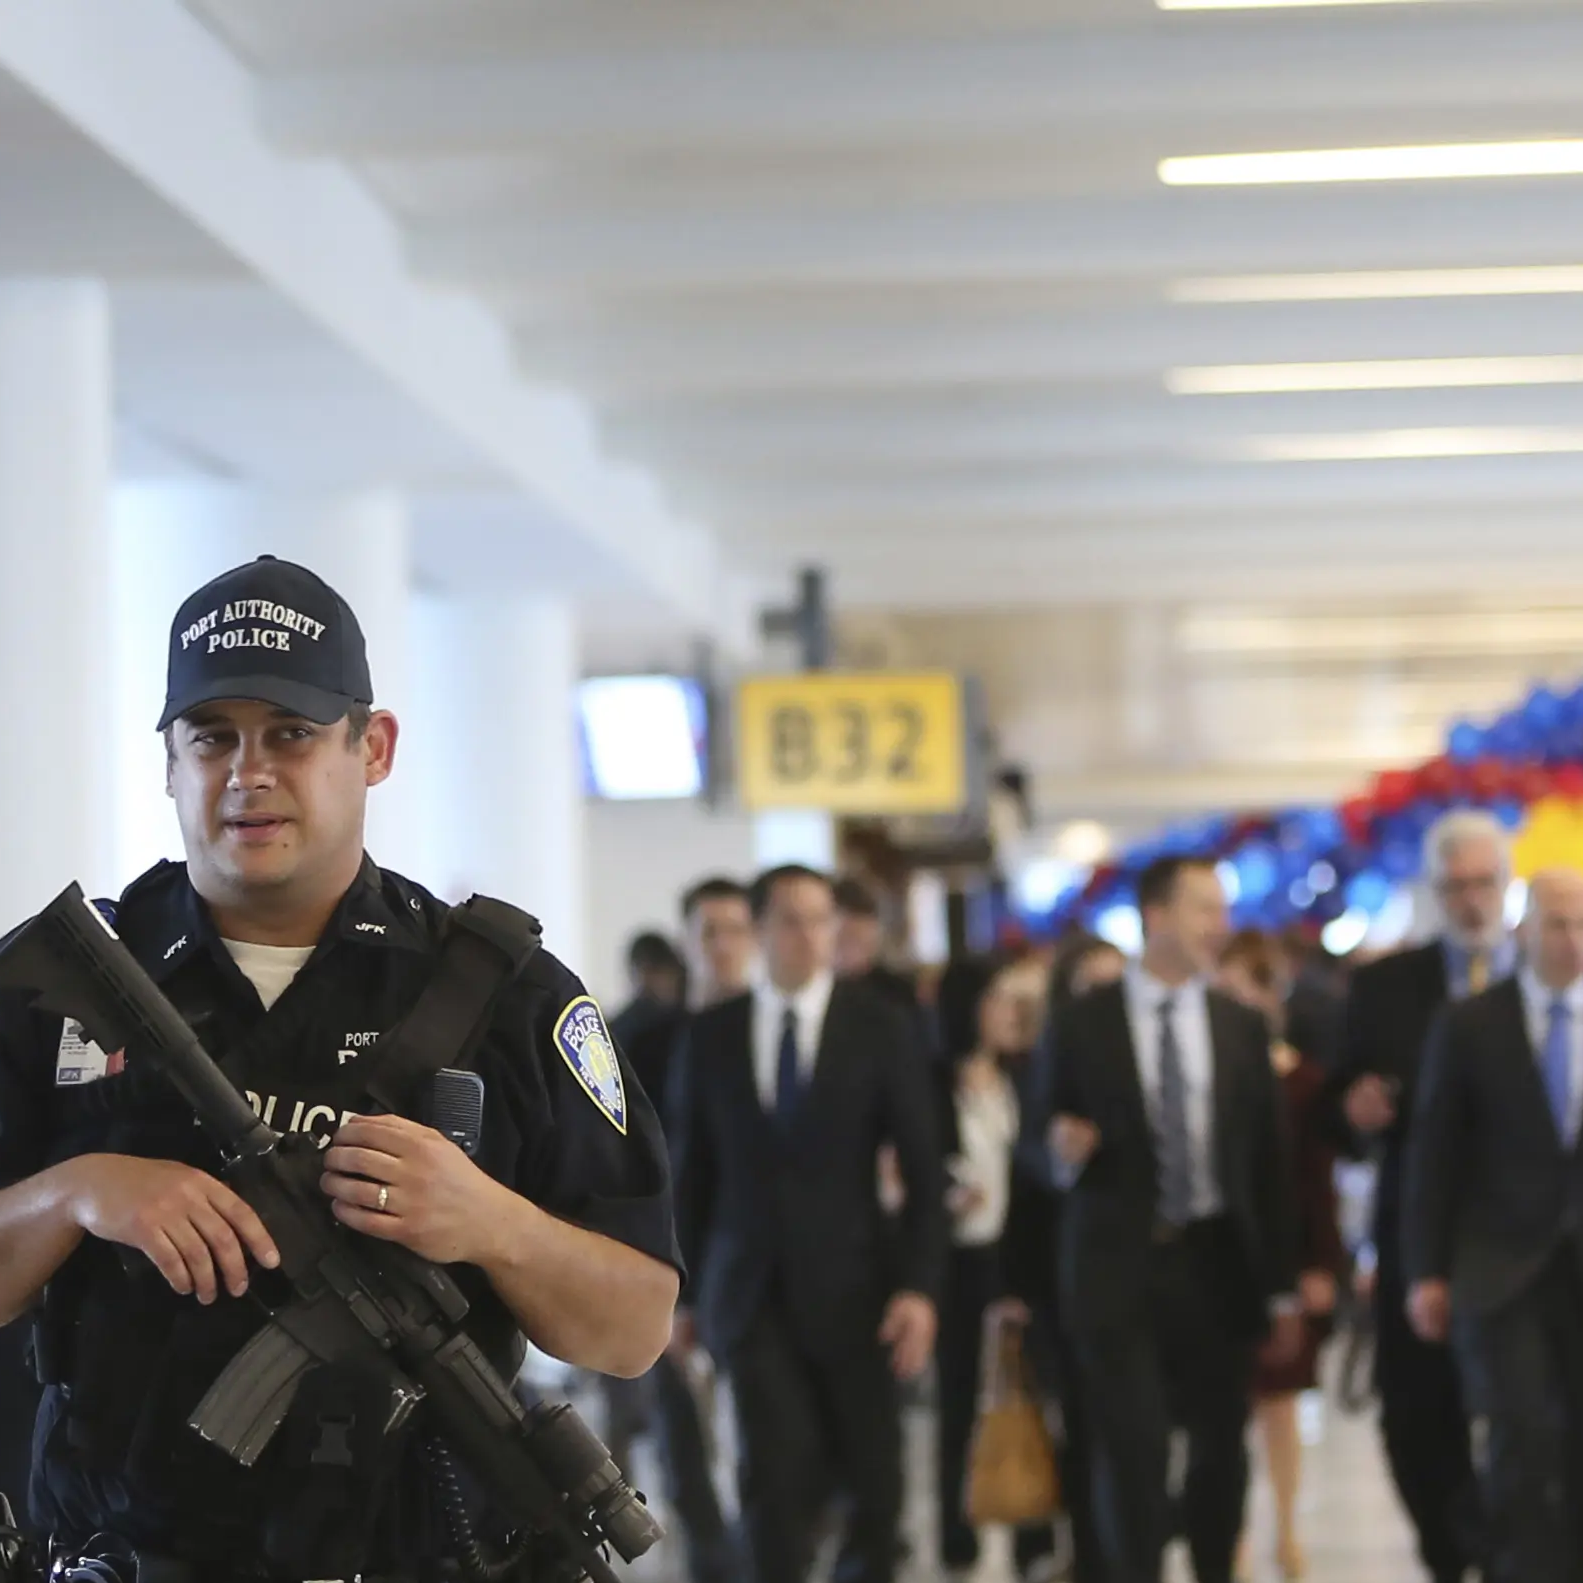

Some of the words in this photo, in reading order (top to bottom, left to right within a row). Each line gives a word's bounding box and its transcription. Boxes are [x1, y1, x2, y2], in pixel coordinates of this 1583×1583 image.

[180, 609, 218, 650] PORT
[223, 599, 326, 641] AUTHORITY
[206, 628, 290, 653] POLICE
[768, 702, 928, 786] B32
[355, 922, 386, 934] JFK
[345, 1032, 380, 1047] PORT
[569, 1016, 601, 1052] POLICE
